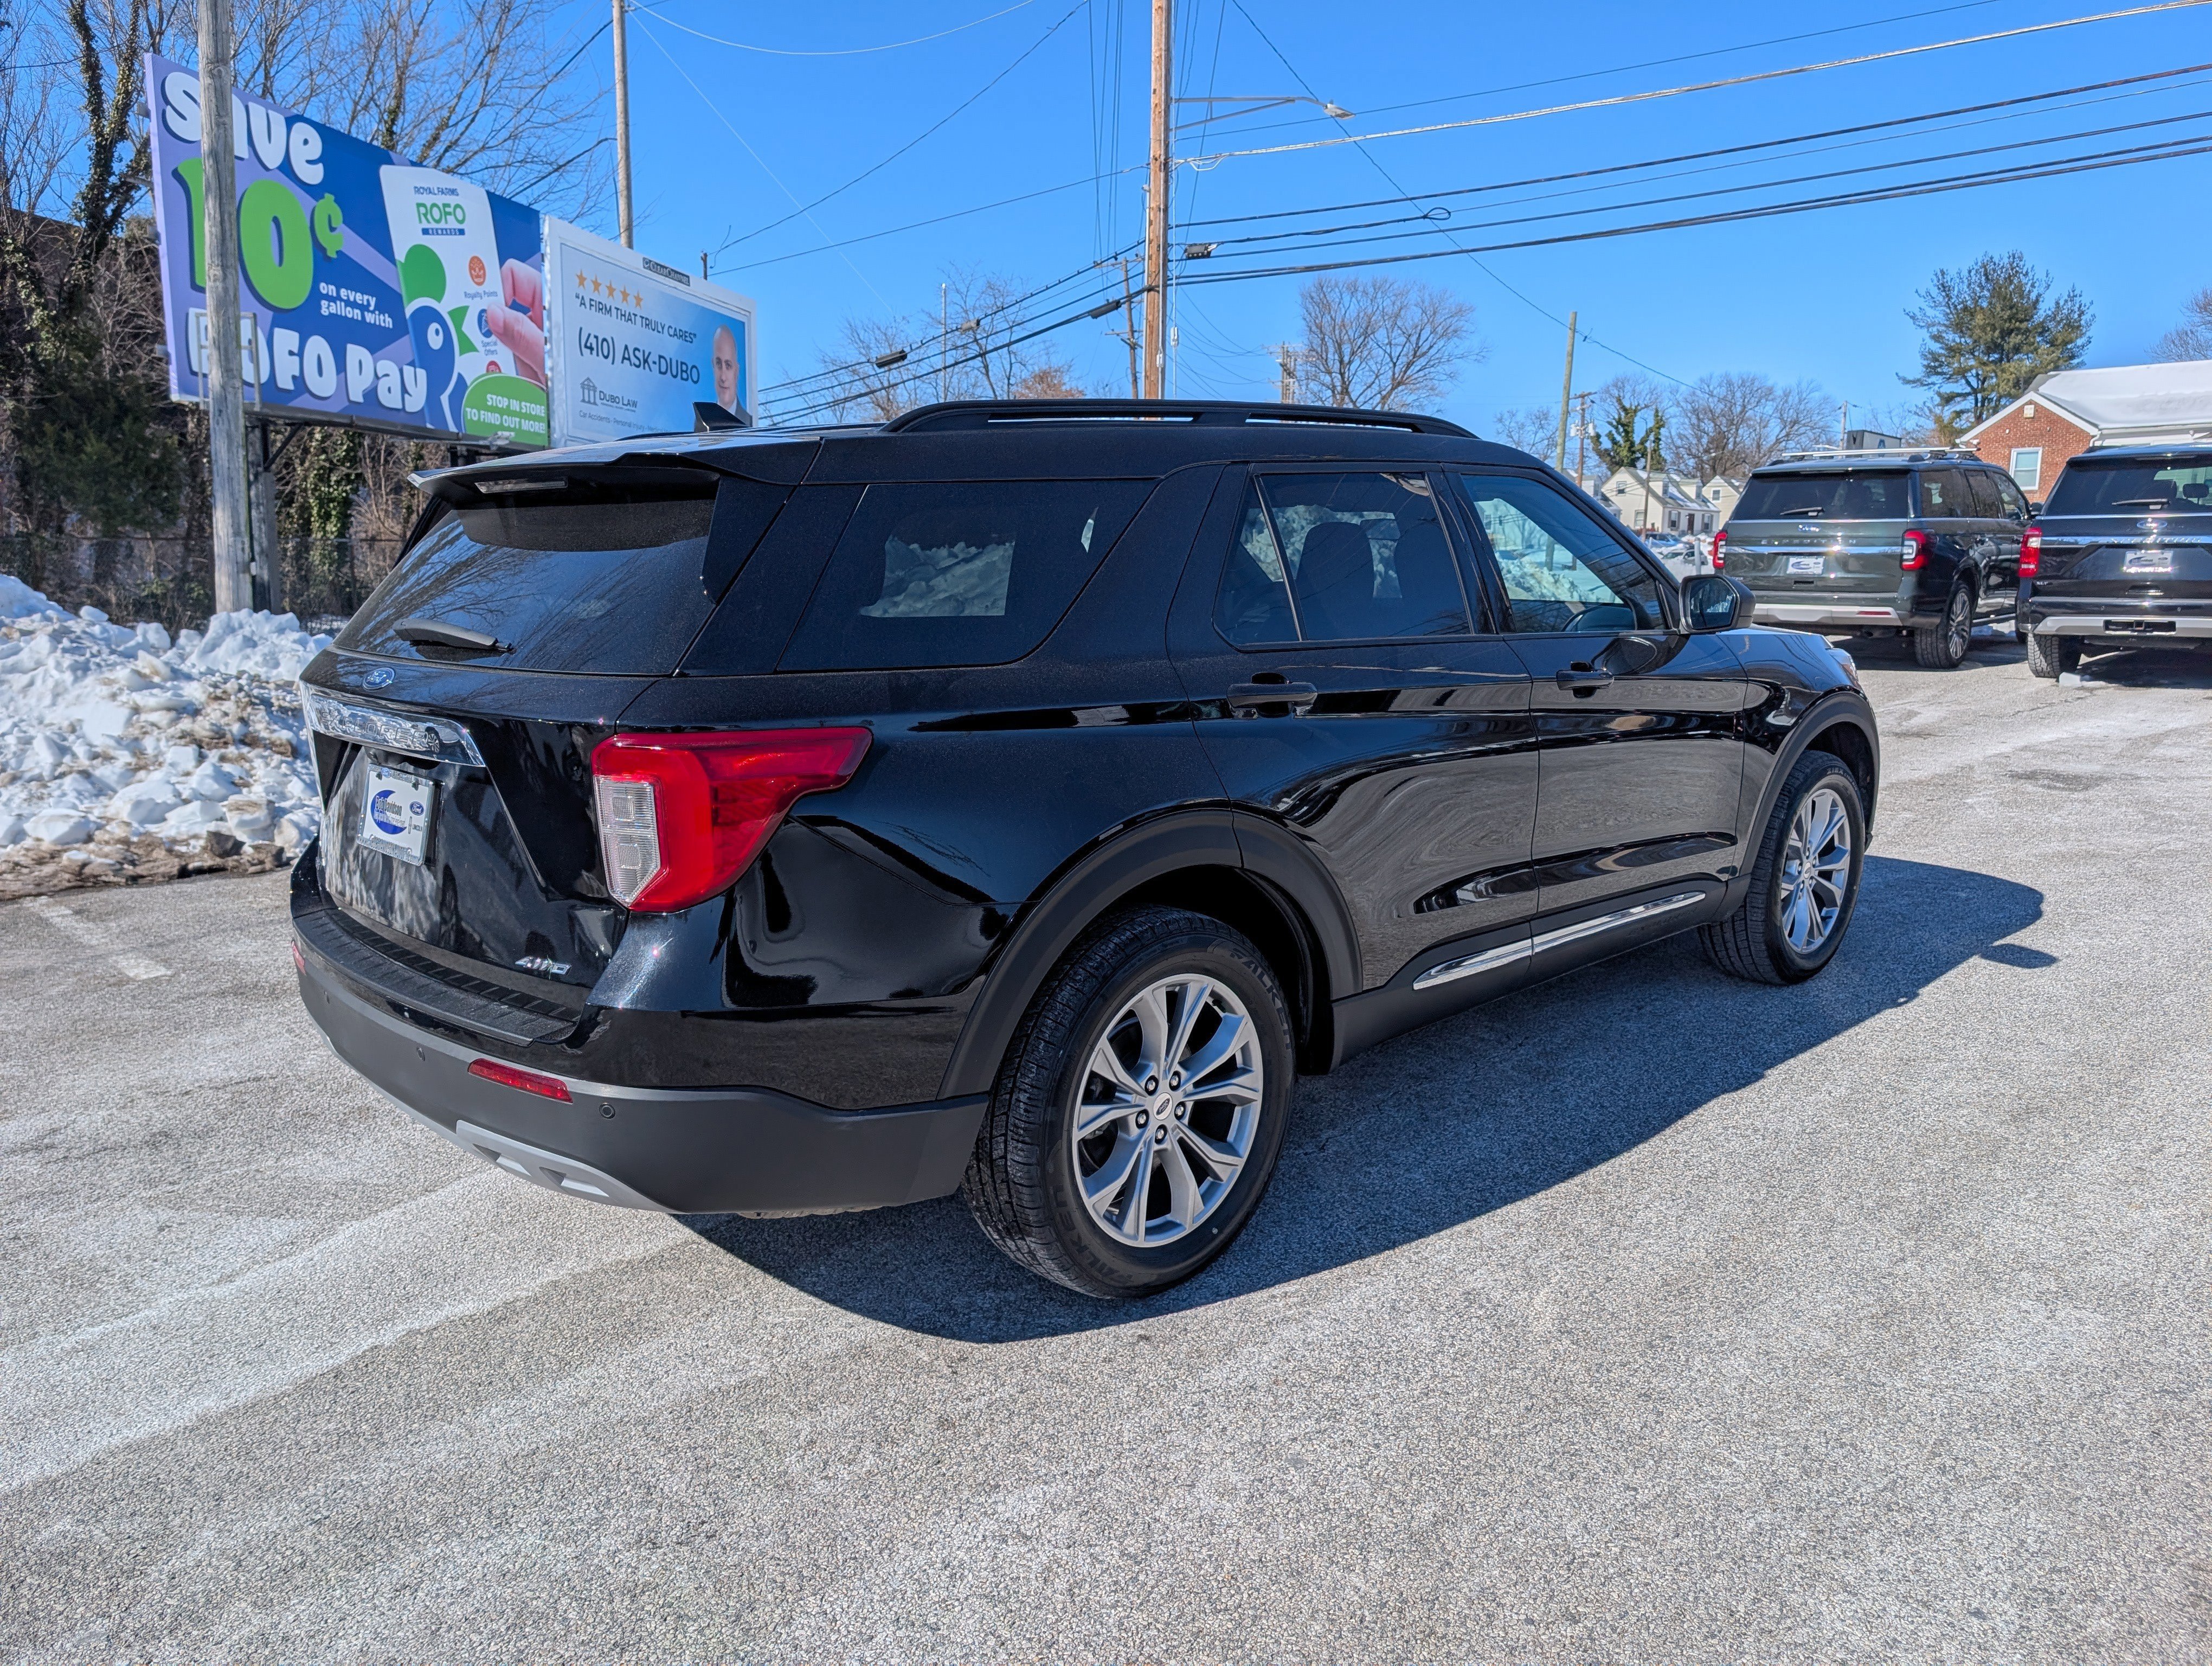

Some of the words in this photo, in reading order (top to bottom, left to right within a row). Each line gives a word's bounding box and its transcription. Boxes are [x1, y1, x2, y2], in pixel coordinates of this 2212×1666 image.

[416, 202, 466, 225] ROFO
[319, 282, 337, 297] on
[340, 287, 376, 311] every
[320, 299, 362, 321] gallon
[364, 310, 393, 329] with
[589, 297, 612, 317] FIRM
[615, 306, 638, 325] THAT
[639, 315, 665, 335] TRULY
[578, 326, 616, 365] (410)
[621, 343, 700, 385] ASK-DUBO
[346, 343, 427, 413] Pay
[486, 393, 509, 409] STOP
[510, 398, 520, 412] IN
[521, 401, 545, 416] STORE
[466, 407, 479, 421] TO
[480, 410, 501, 425] FIND
[502, 415, 520, 429] OUT
[521, 419, 545, 433] MORE!
[321, 712, 428, 748] EXPLORER
